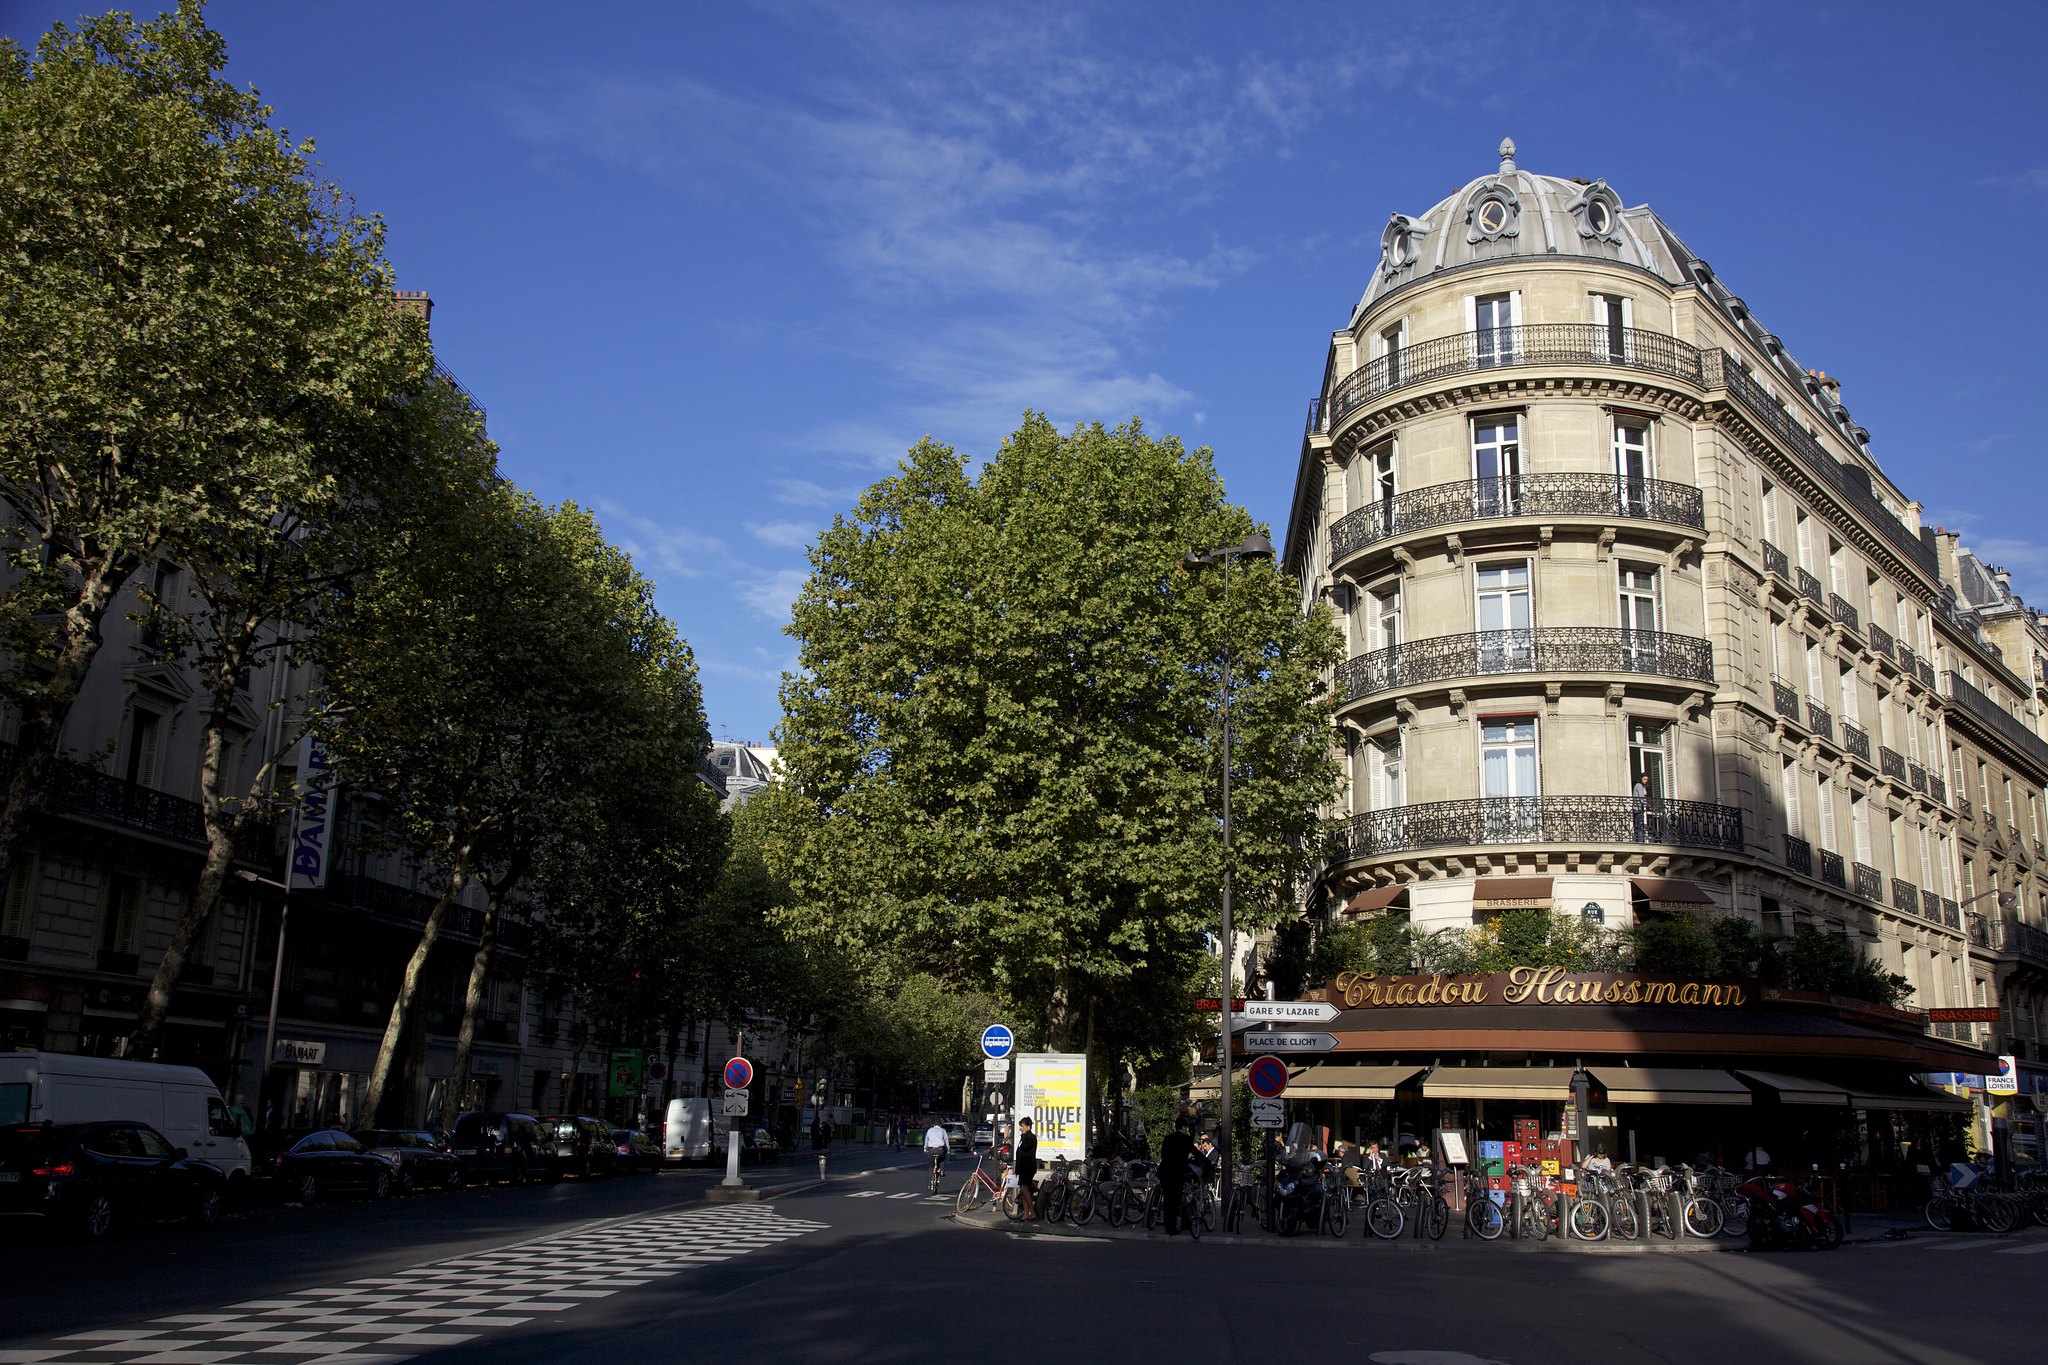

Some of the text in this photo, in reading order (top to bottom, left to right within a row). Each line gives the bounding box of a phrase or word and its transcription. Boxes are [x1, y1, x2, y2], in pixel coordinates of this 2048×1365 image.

[1660, 901, 1703, 910] BRASSERIE
[1336, 965, 1747, 1008] Triadou Haussmann
[1249, 1007, 1273, 1015] GARE
[1286, 1008, 1320, 1016] LAZARE
[1931, 1009, 1999, 1021] BRASSERIE
[1249, 1038, 1317, 1046] PLACE DE CLICHY
